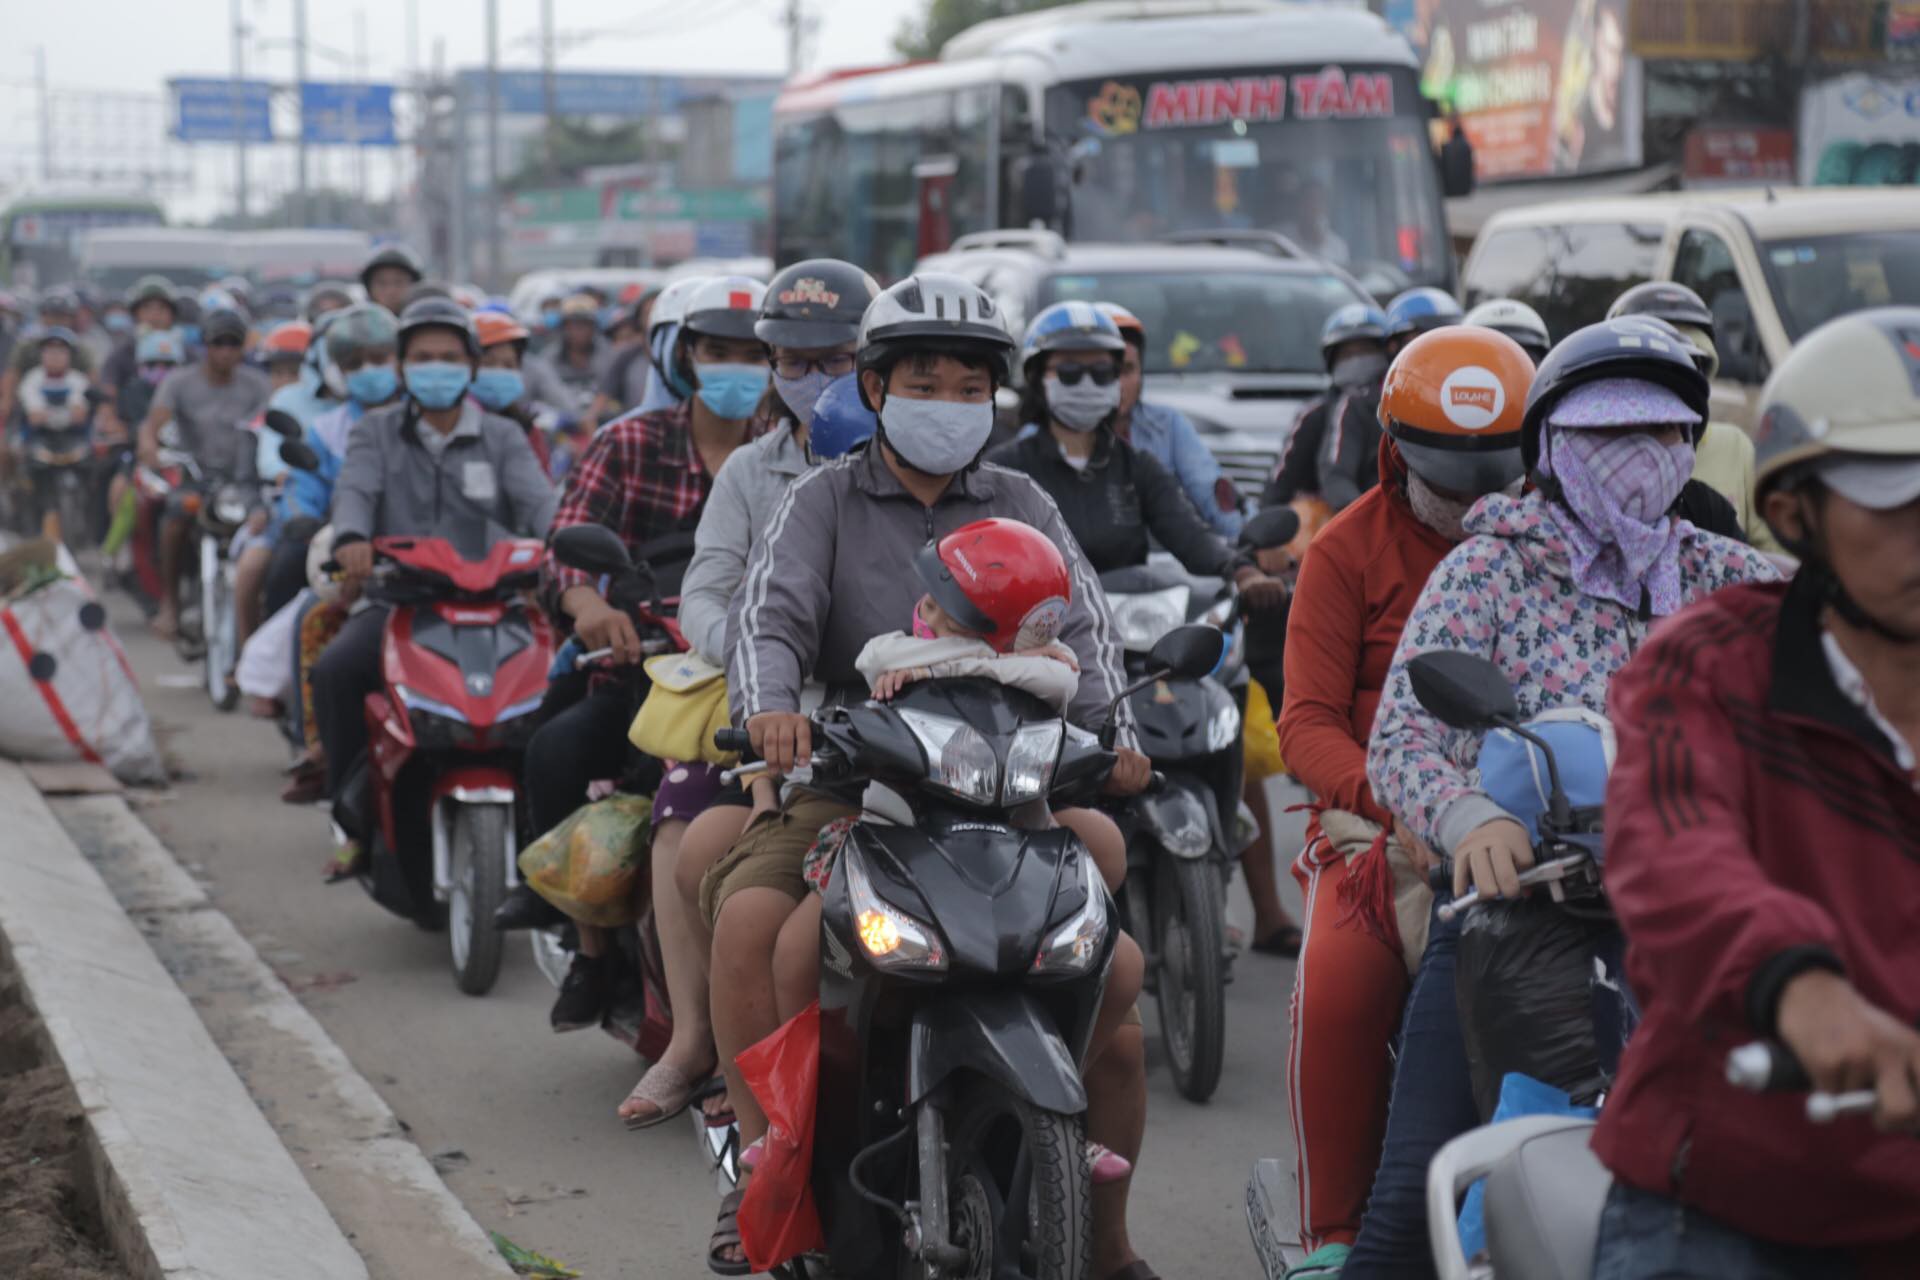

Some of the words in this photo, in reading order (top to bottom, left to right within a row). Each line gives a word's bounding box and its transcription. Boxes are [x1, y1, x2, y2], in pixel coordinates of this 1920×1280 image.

[1143, 77, 1286, 128] MINH
[1291, 65, 1394, 119] TÂM
[953, 547, 977, 582] HONDA
[951, 822, 1007, 834] HONDA
